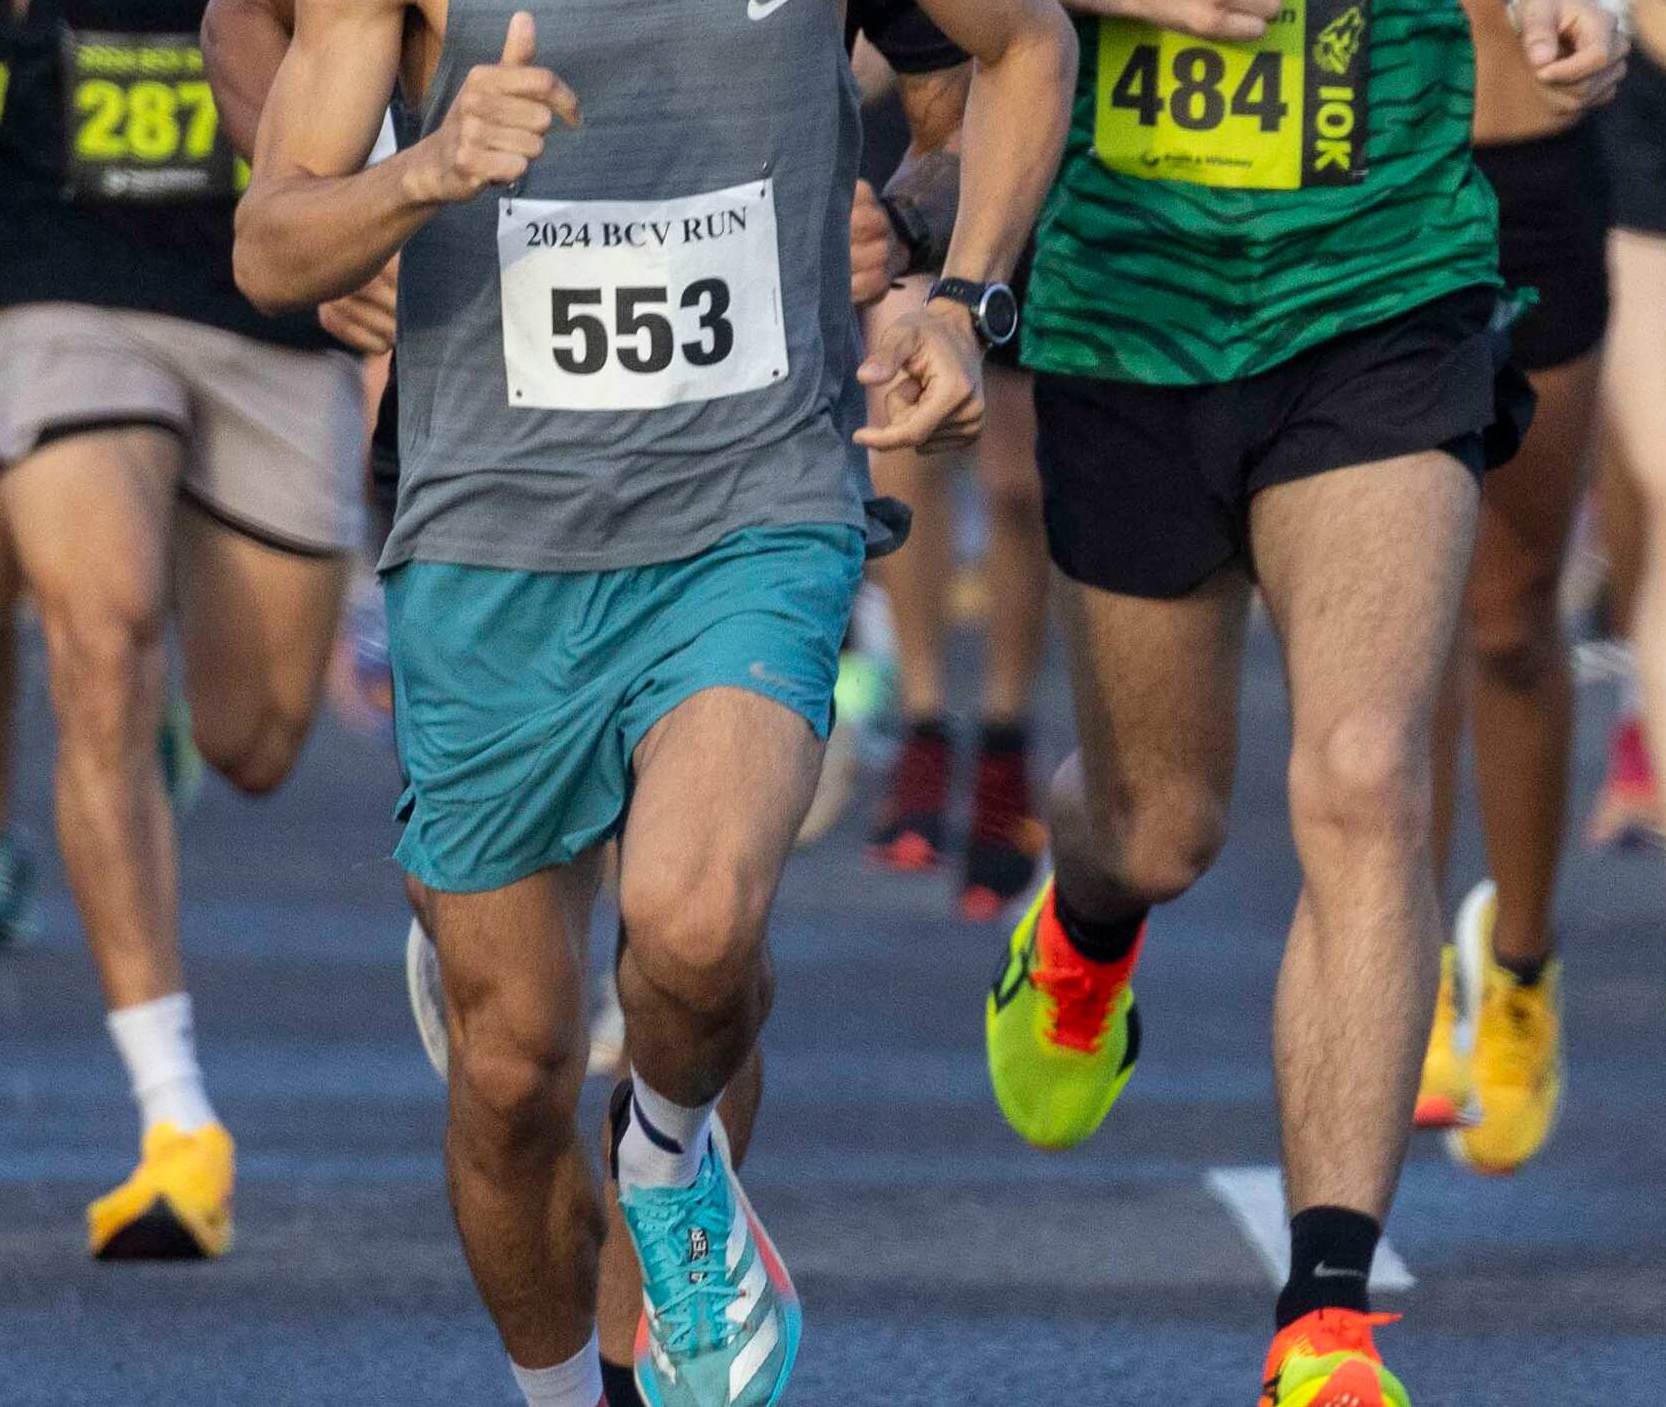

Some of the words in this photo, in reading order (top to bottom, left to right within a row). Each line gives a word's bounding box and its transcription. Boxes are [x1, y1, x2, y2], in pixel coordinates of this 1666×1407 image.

[74, 79, 218, 162] 287
[1111, 44, 1288, 133] 484
[525, 222, 591, 247] 2024
[603, 221, 671, 247] BCV
[681, 207, 748, 243] RUN
[551, 277, 734, 374] 553
